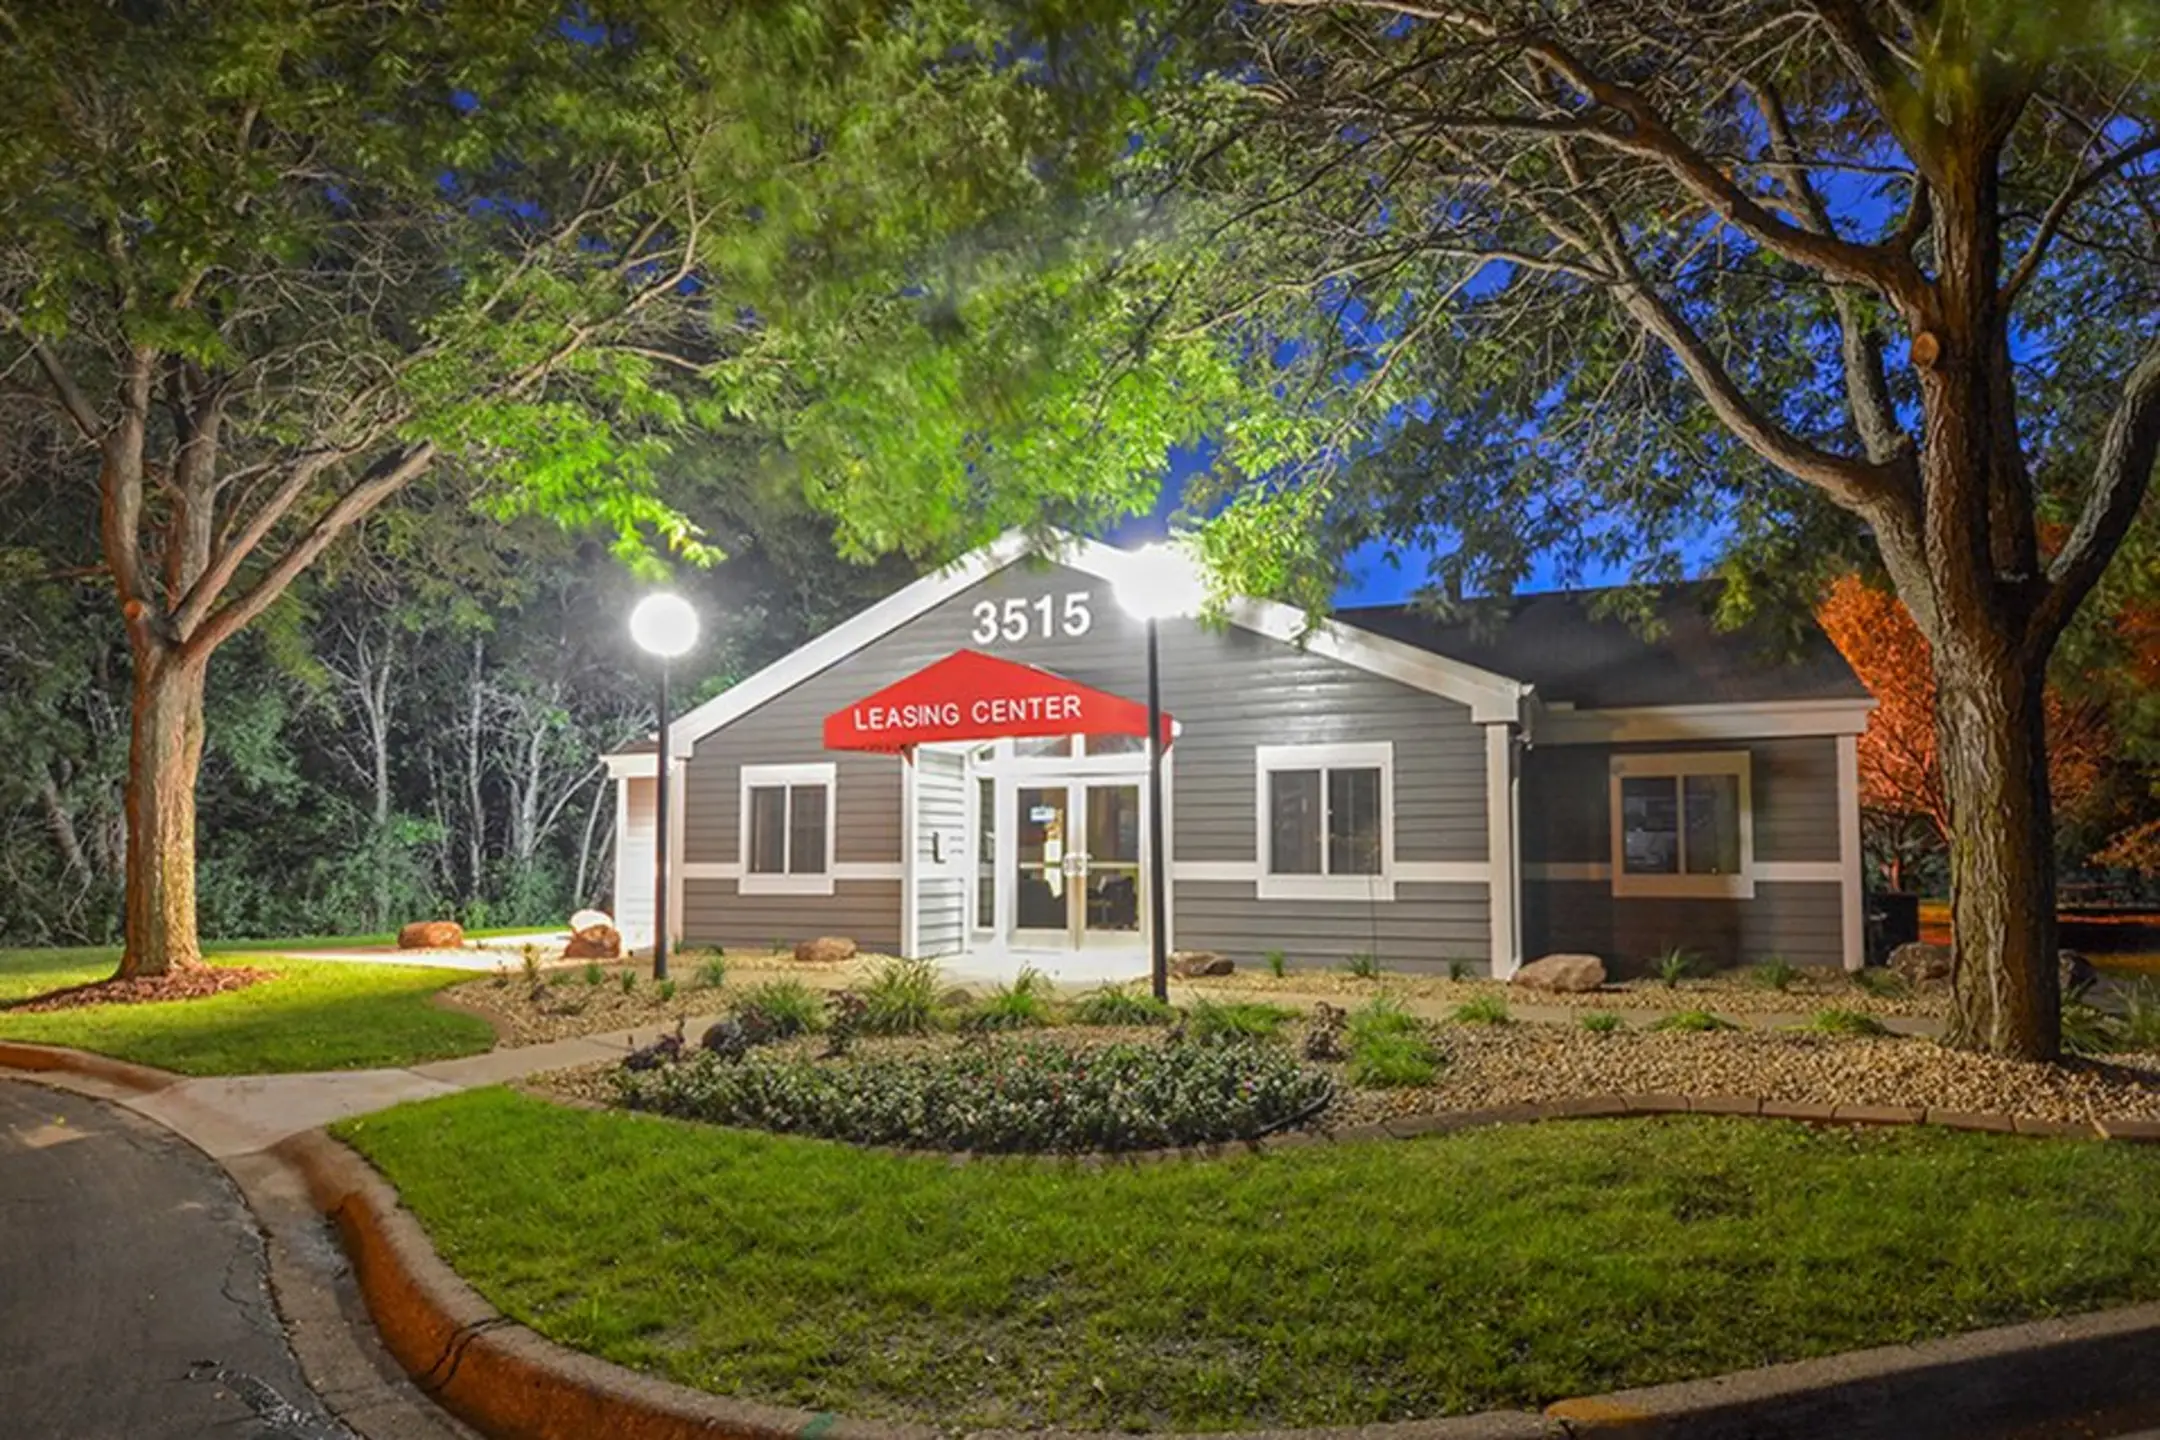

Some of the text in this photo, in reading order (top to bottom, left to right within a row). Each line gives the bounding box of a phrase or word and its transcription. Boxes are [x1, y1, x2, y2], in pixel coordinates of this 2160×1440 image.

[972, 592, 1091, 644] 3515
[854, 694, 1082, 731] LEASING CENTER
